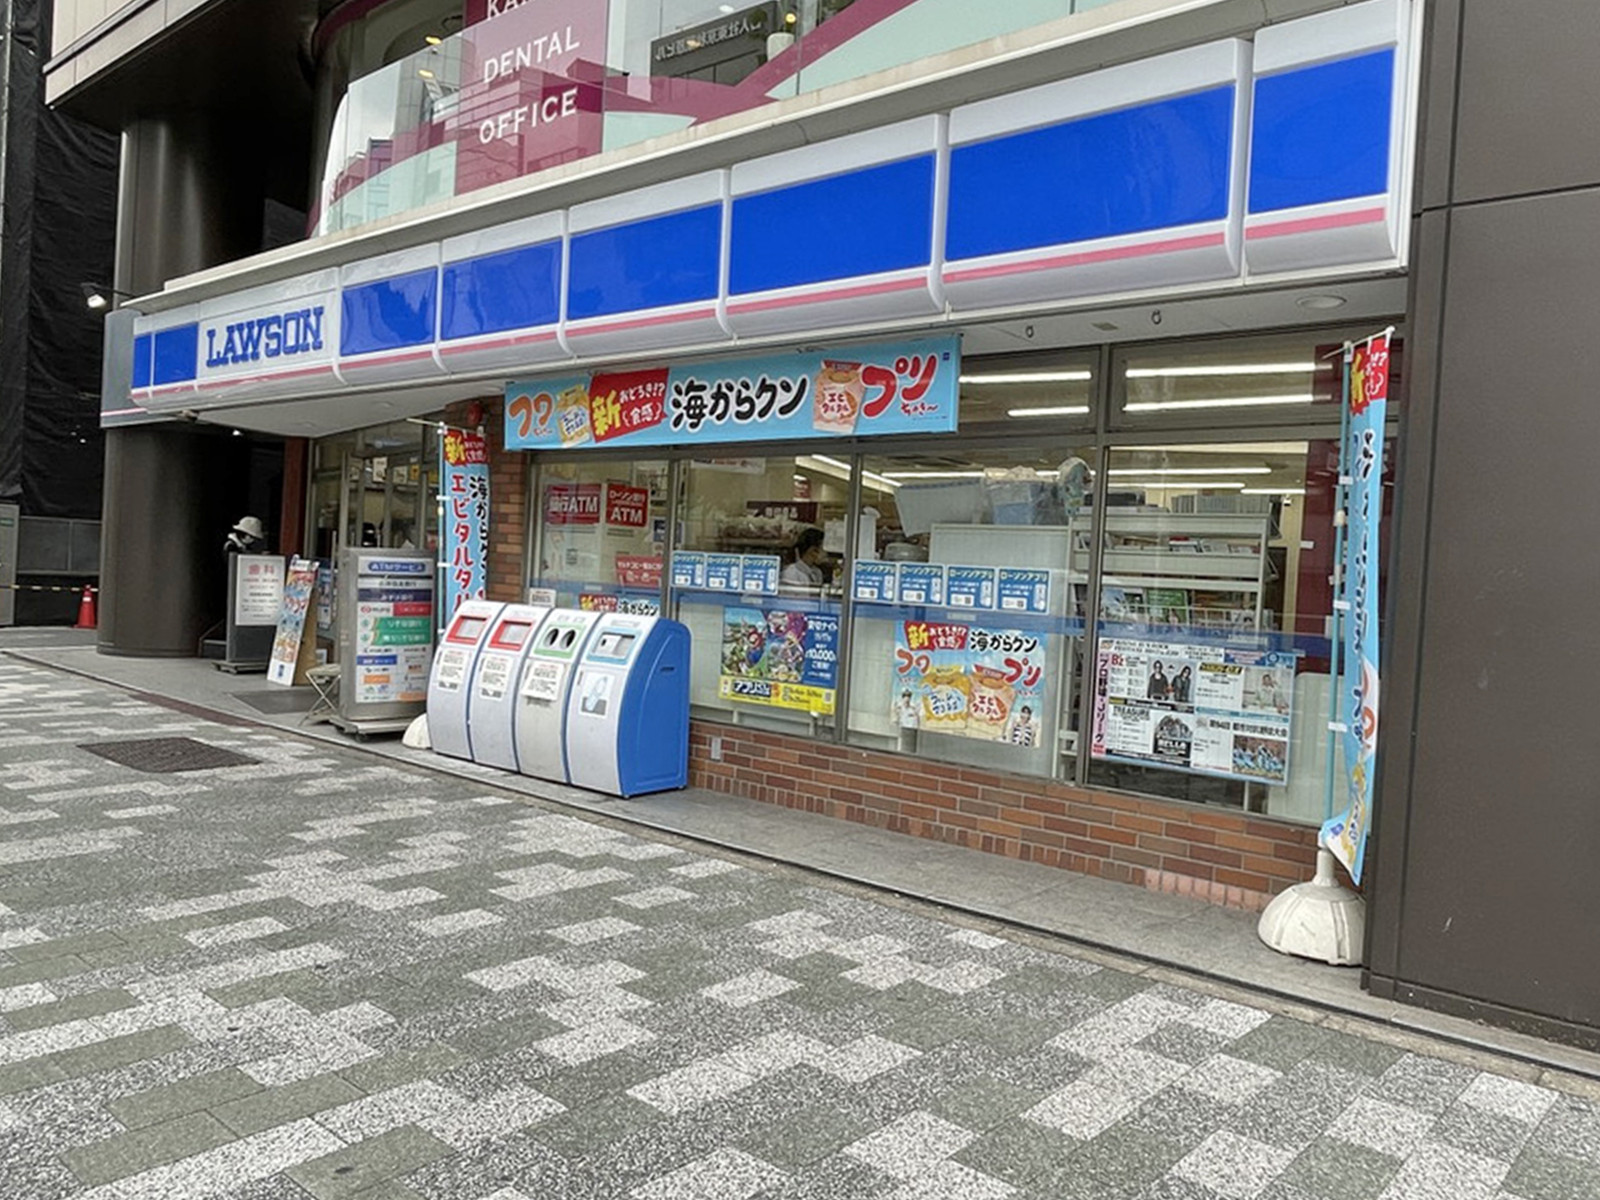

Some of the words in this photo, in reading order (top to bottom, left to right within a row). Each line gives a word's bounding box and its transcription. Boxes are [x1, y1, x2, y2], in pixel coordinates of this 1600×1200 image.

[483, 26, 581, 84] DENTAL
[479, 86, 579, 144] OFFICE
[206, 306, 325, 368] LAWSON
[591, 389, 621, 437] 新
[671, 375, 809, 431] 海からクン
[610, 506, 644, 524] ATM
[907, 623, 930, 650] 新
[970, 629, 1038, 652] 海からクン
